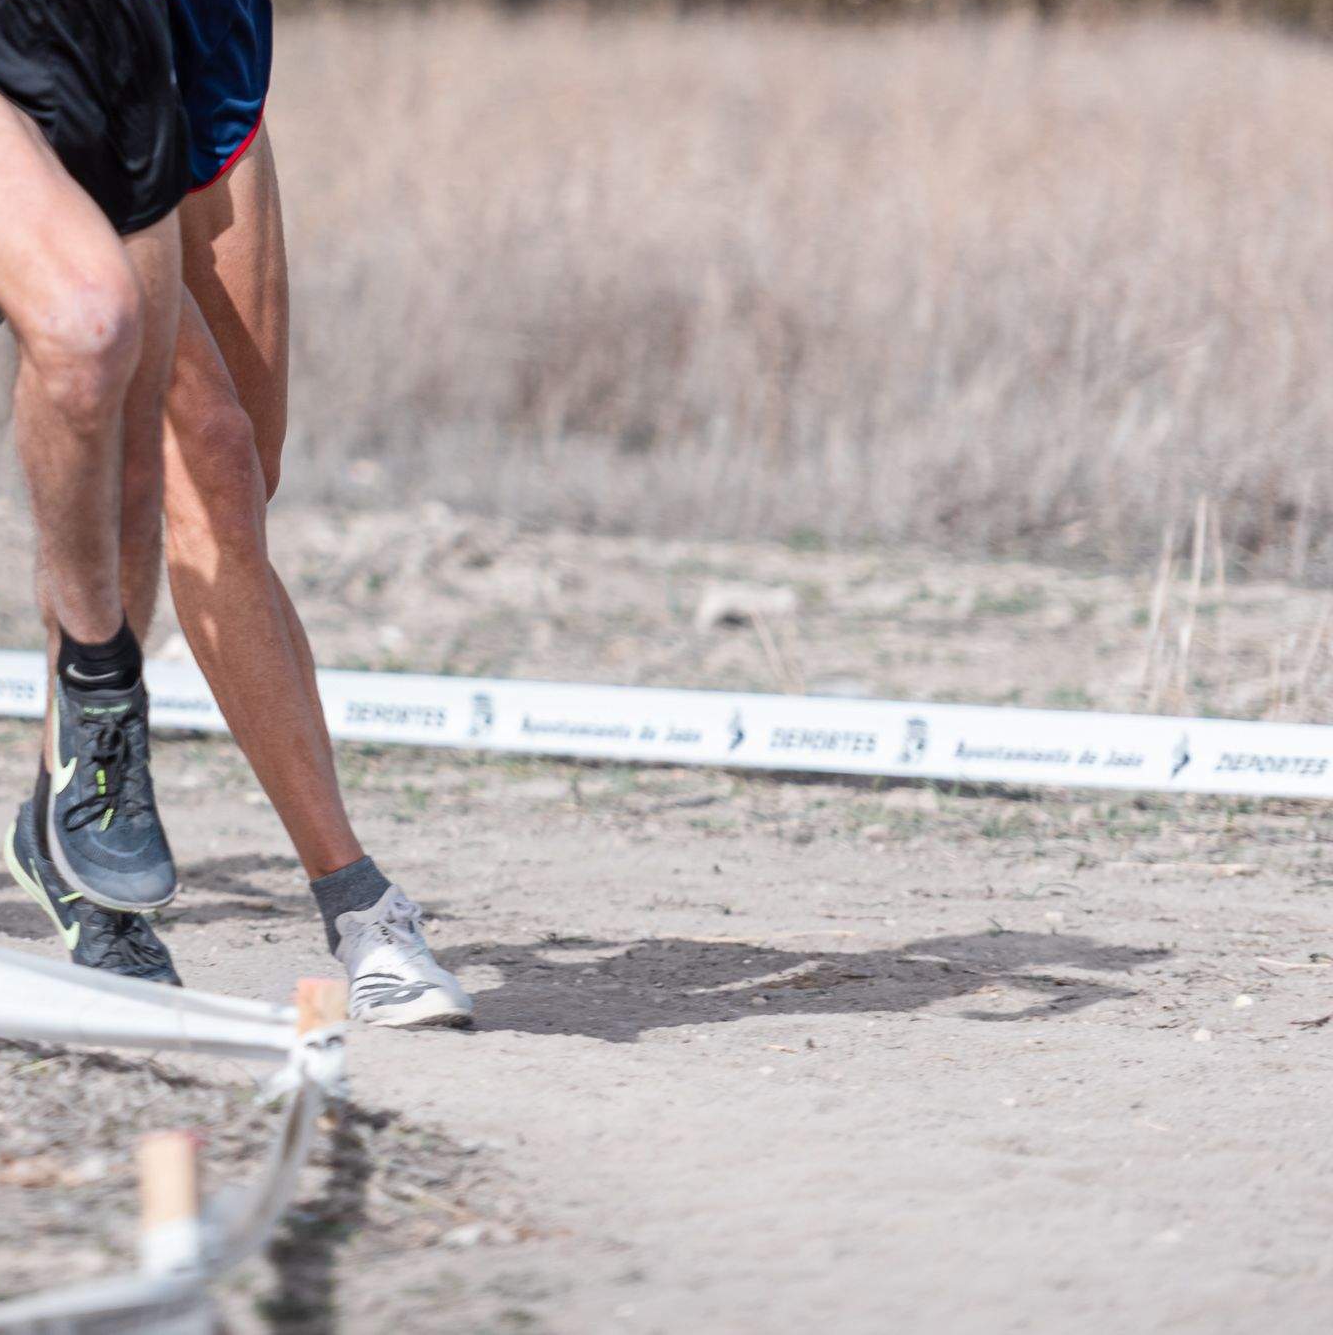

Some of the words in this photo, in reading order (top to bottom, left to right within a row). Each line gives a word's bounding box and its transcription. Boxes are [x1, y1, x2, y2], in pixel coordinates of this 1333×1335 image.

[345, 701, 448, 727] DEPORTES
[769, 726, 878, 754] DEPORTES
[1213, 751, 1331, 777] DEPORTES
